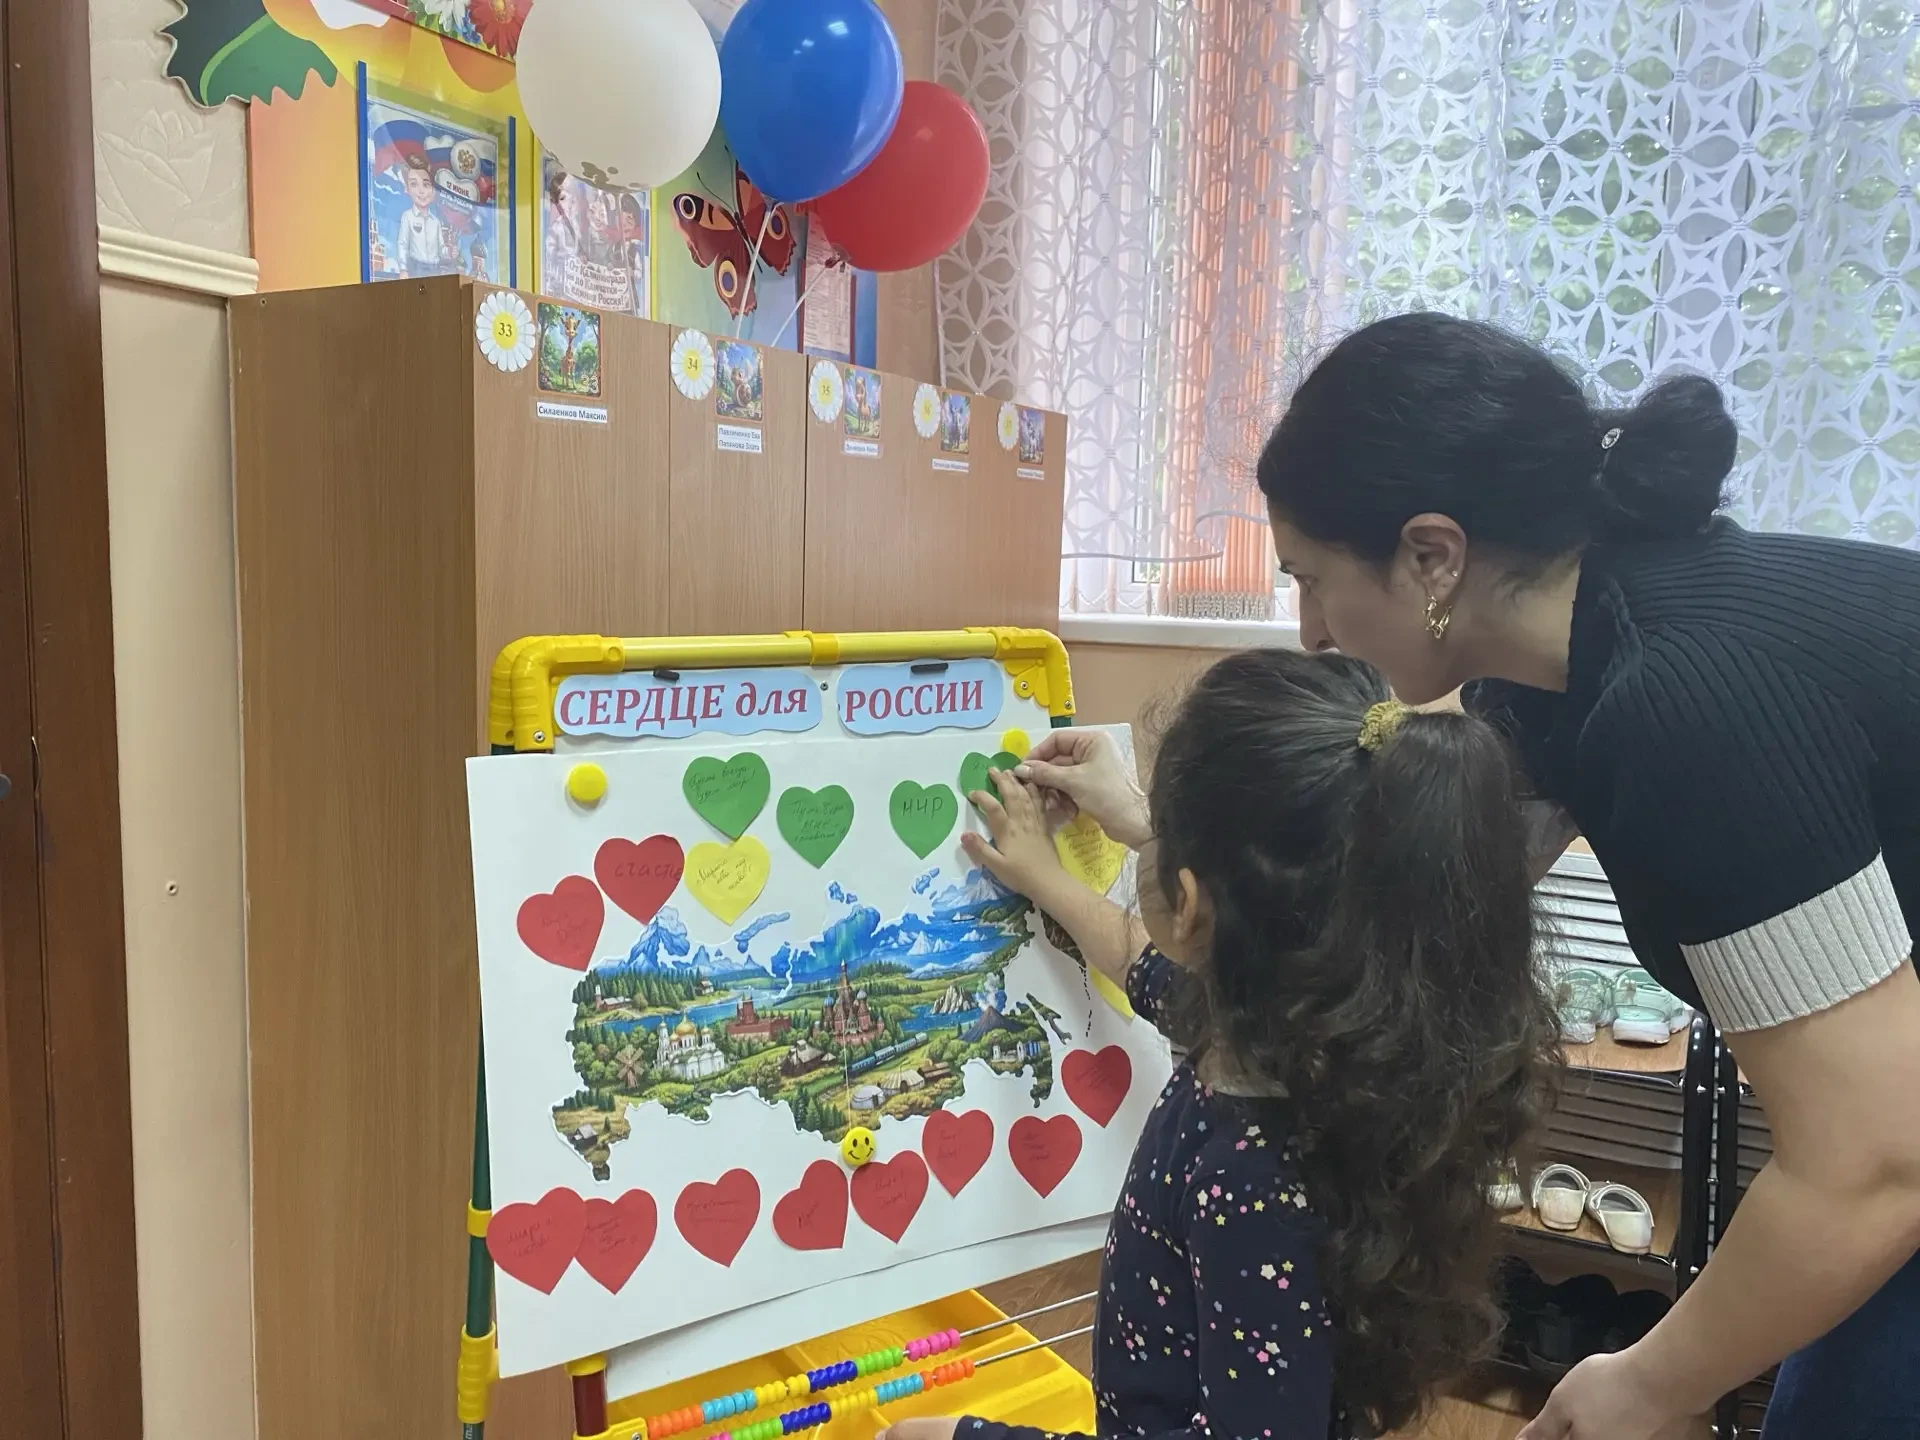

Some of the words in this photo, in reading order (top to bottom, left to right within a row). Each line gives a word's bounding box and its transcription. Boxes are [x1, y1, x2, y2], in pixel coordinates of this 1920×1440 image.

[498, 322, 513, 338] 33
[687, 357, 698, 371] 34
[578, 410, 607, 421] Максим
[560, 684, 726, 731] СЕРДЦЕ
[735, 682, 807, 717] для
[845, 679, 984, 723] РОССИИ
